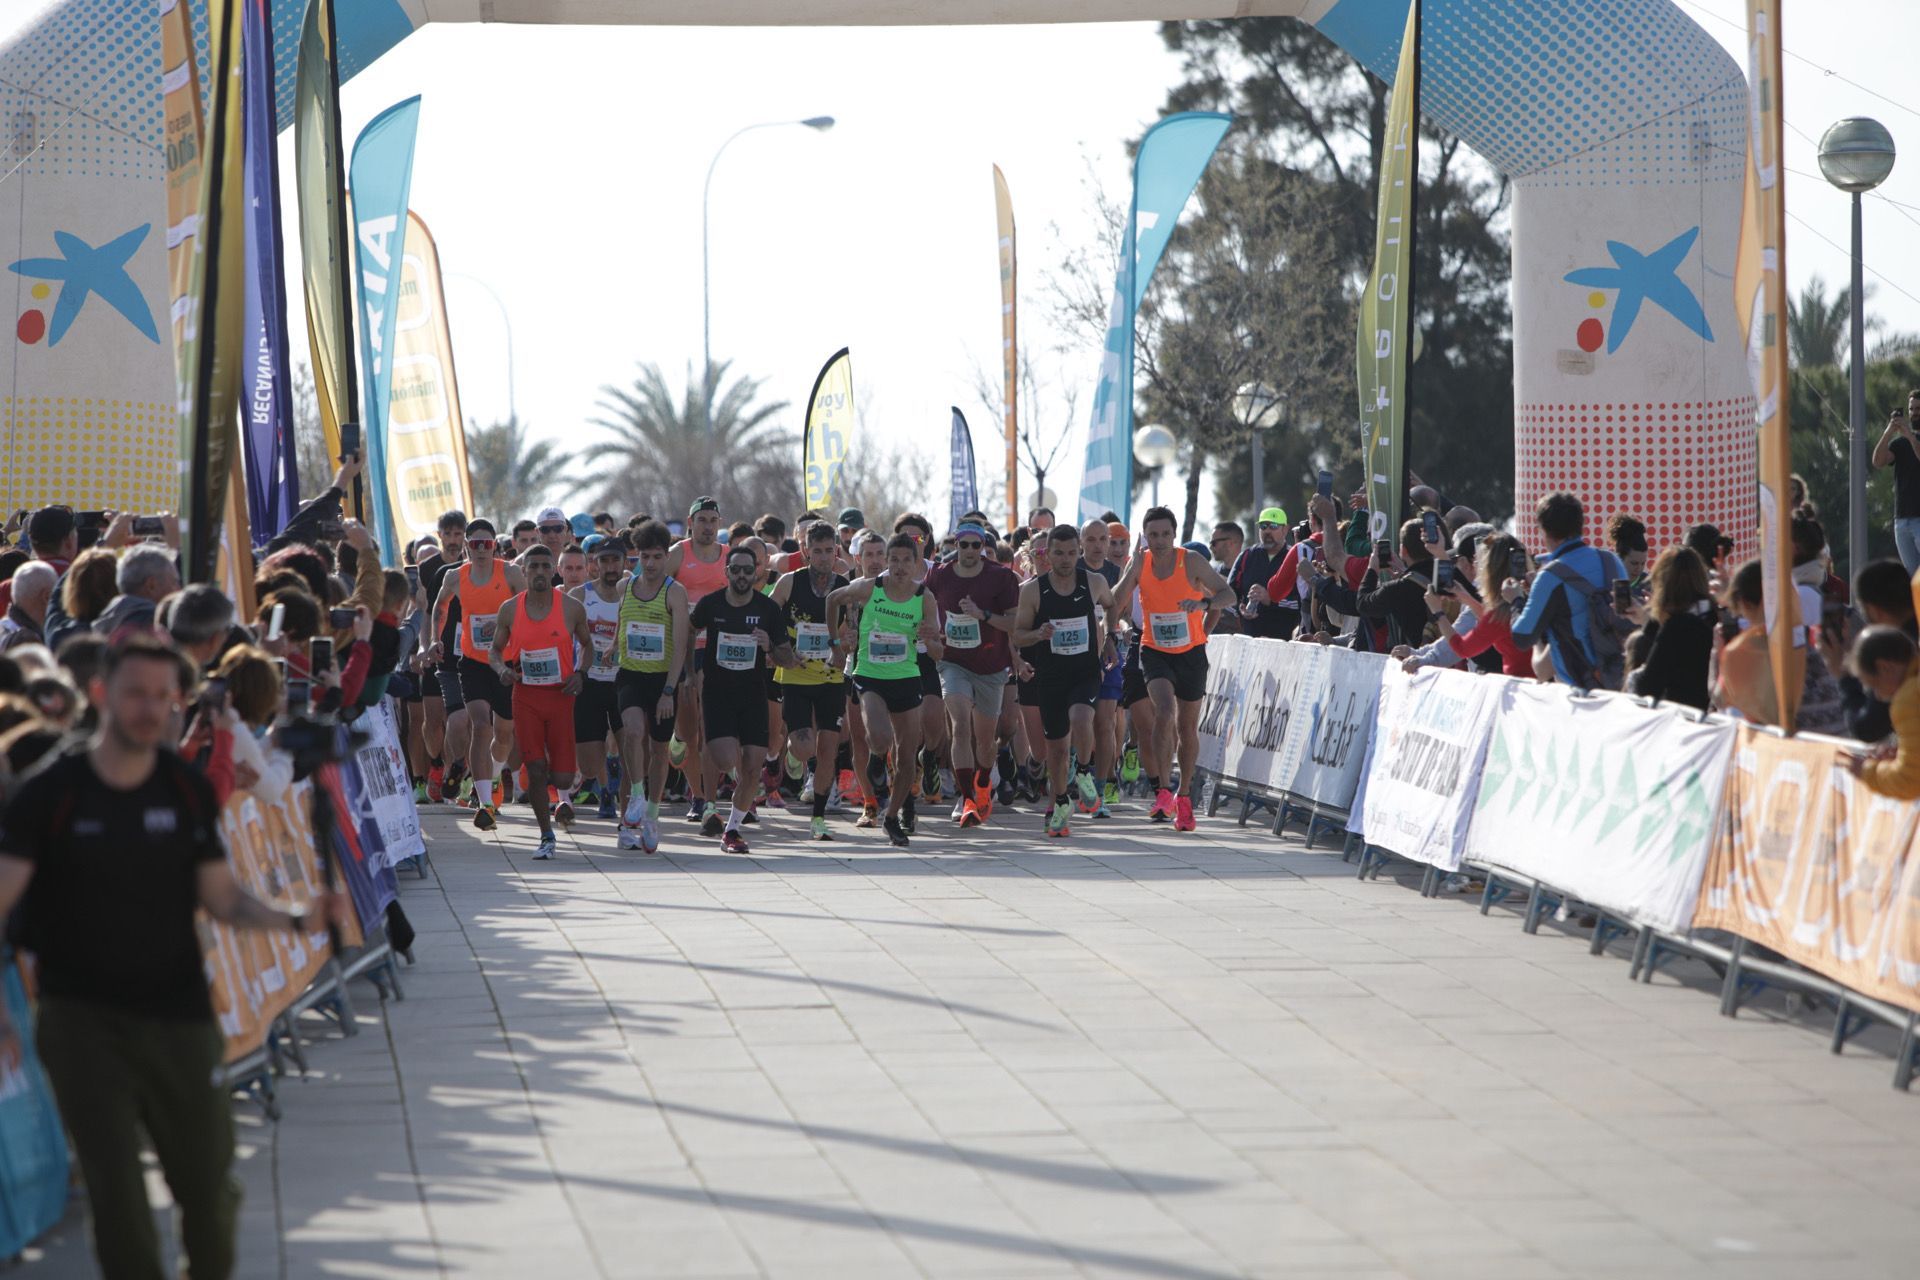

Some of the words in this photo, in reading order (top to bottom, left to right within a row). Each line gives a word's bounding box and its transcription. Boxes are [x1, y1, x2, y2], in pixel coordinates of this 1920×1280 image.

[817, 392, 845, 409] voy
[951, 625, 969, 636] 514
[1160, 625, 1178, 636] 647
[640, 636, 647, 647] 3
[809, 635, 821, 646] 18
[1060, 631, 1079, 642] 125
[726, 646, 746, 657] 668
[529, 662, 548, 673] 581
